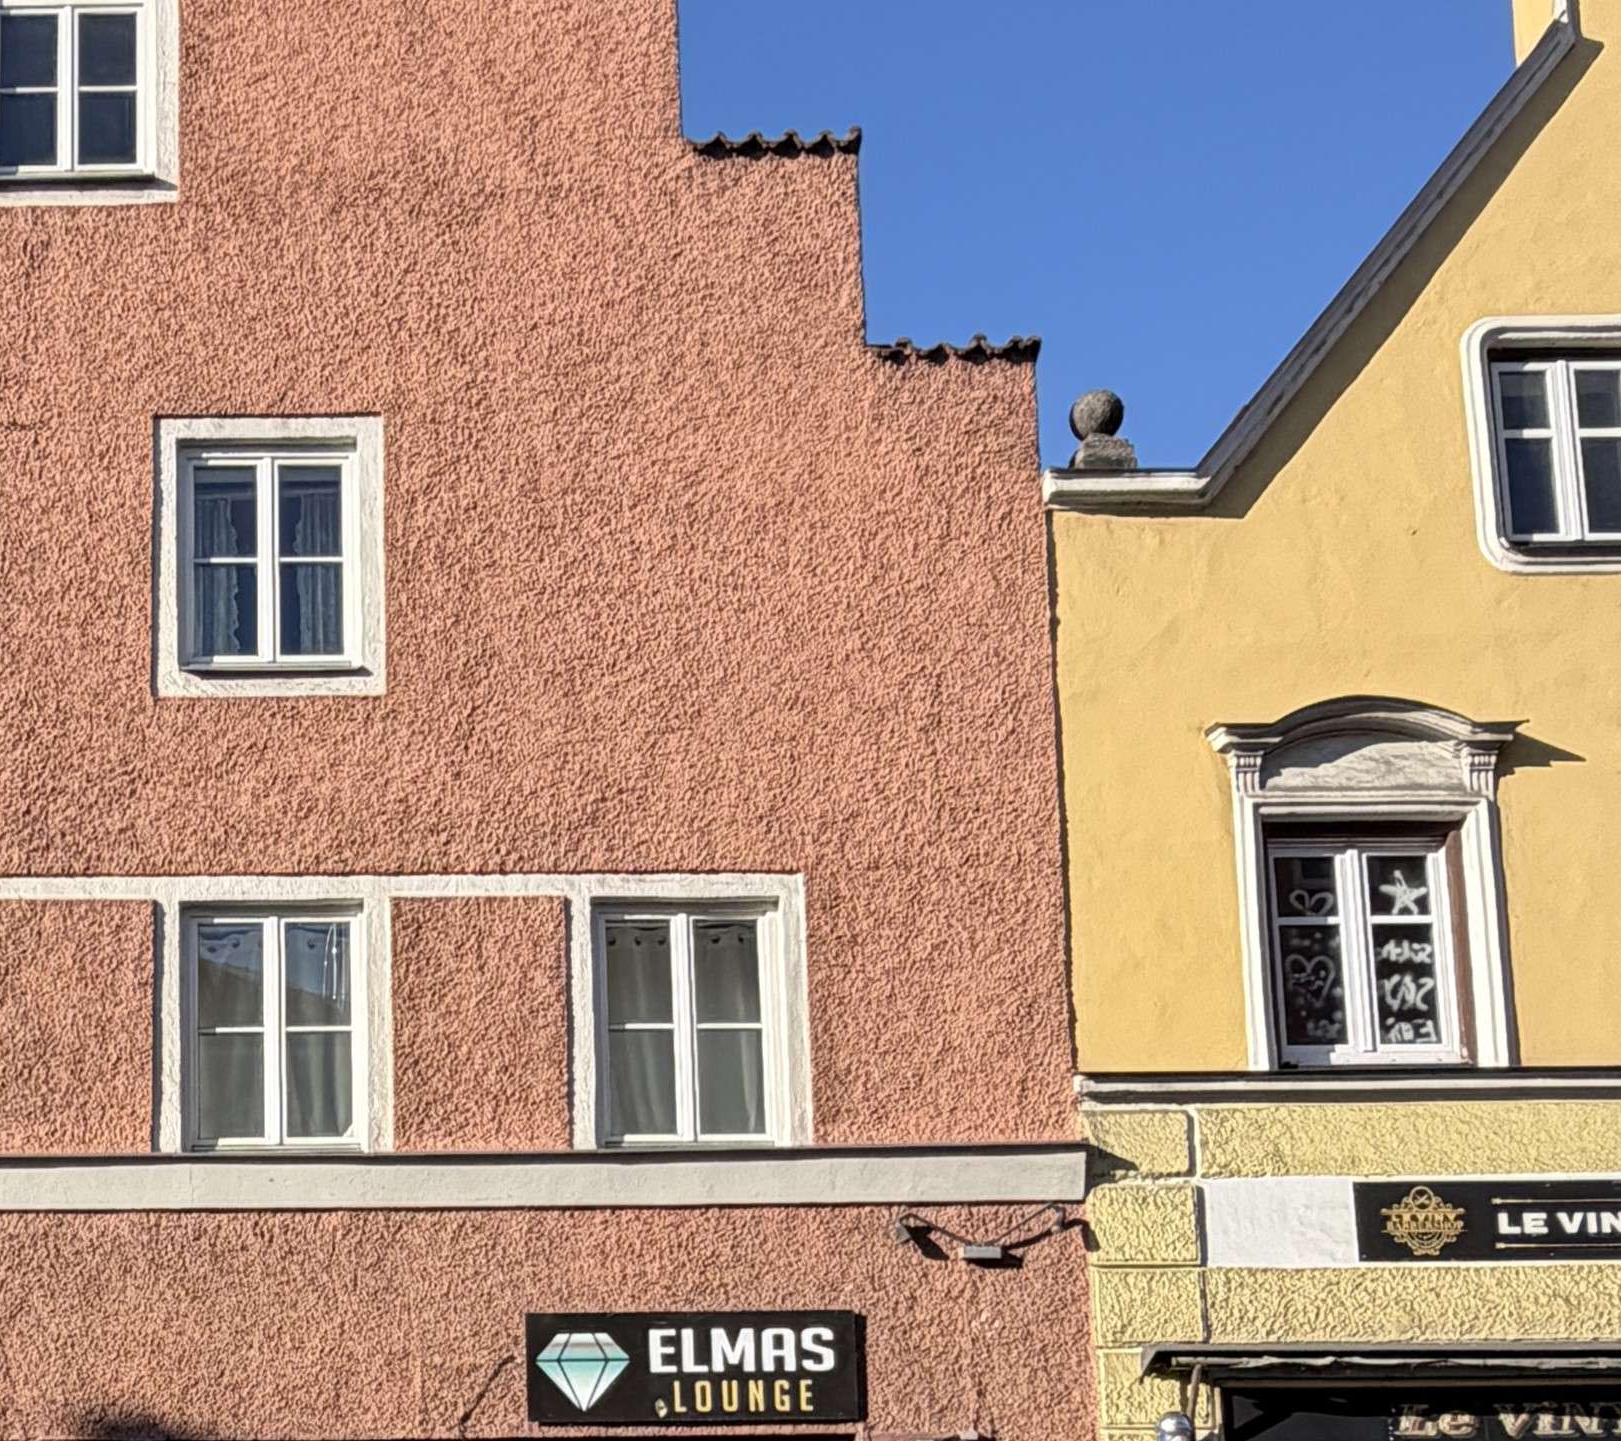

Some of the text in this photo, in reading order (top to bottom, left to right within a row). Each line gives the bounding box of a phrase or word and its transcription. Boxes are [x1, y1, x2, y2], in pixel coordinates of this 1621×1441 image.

[1497, 1212, 1549, 1234] LE
[648, 1327, 835, 1373] ELMAS
[673, 1379, 815, 1412] LOUNGE
